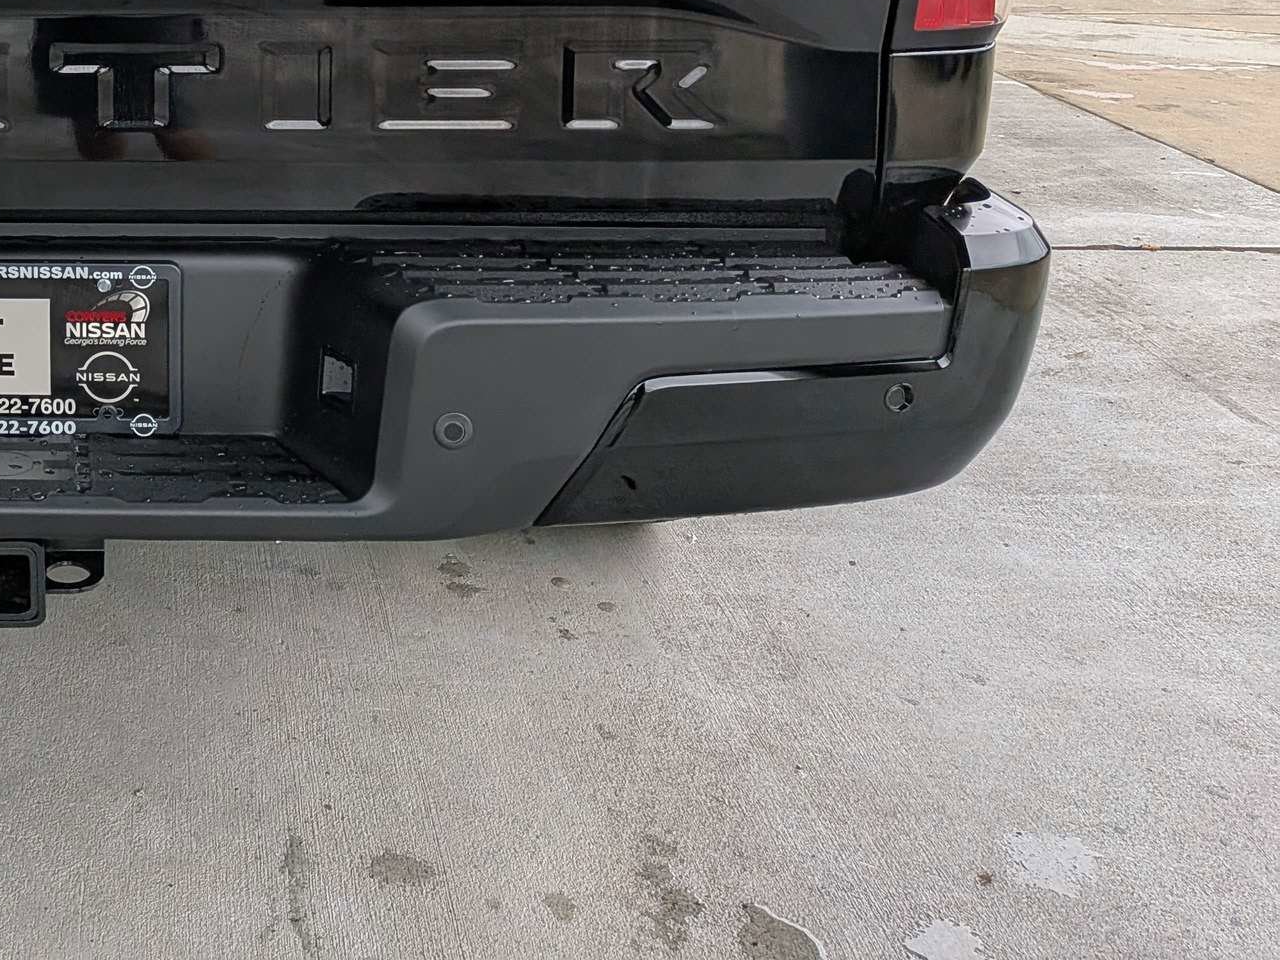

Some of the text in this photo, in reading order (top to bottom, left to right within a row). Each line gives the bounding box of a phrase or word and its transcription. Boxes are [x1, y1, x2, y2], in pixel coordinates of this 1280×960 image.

[65, 322, 146, 338] NISSAN
[100, 338, 124, 347] Driving
[76, 372, 140, 382] NISSAN
